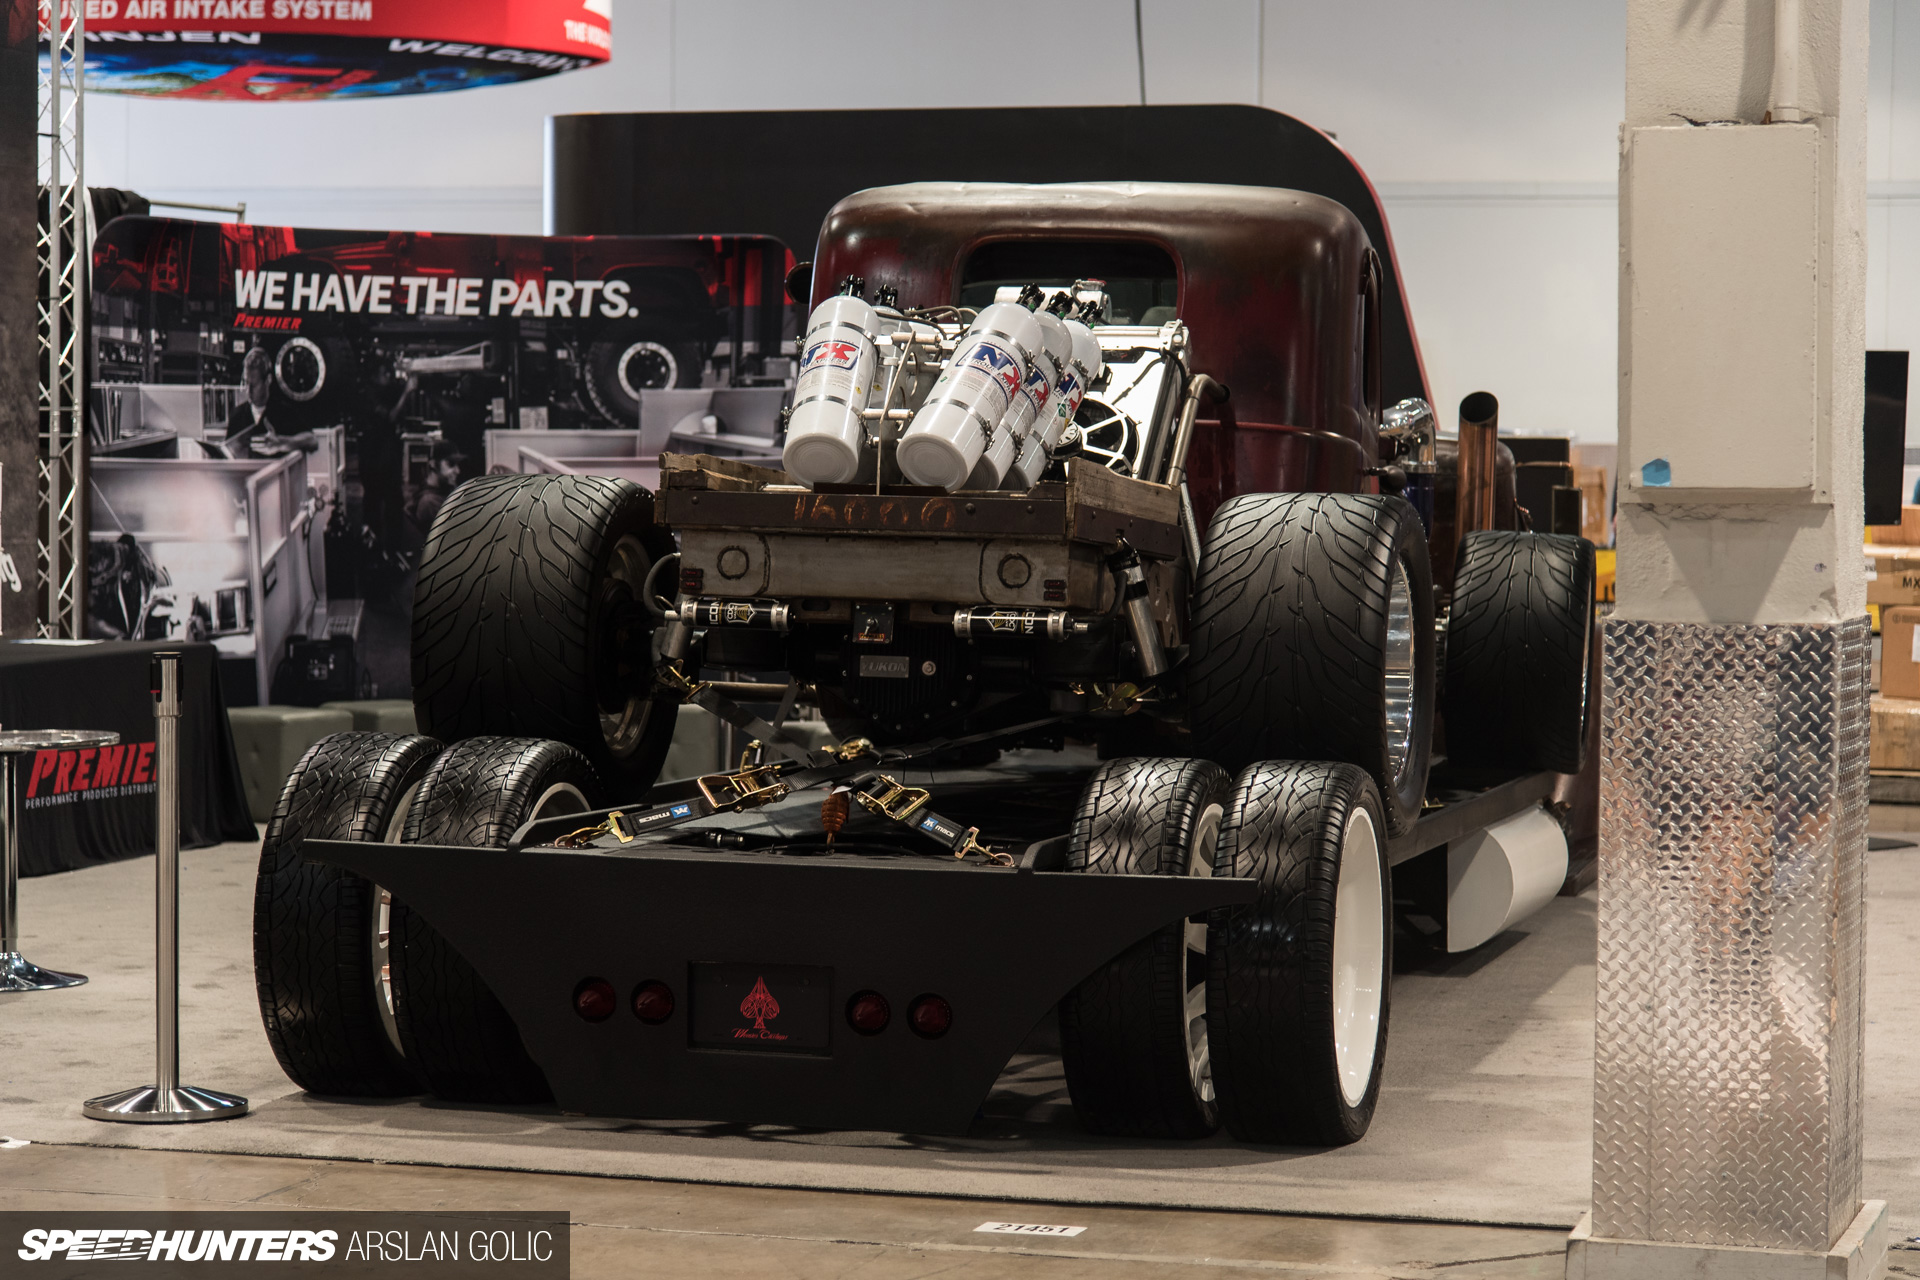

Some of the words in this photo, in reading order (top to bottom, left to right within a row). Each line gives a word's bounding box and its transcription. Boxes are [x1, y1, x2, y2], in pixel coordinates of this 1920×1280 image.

[124, 0, 172, 20] AIR
[174, 0, 265, 20] INTAKE
[271, 0, 373, 21] SYSTEM
[234, 269, 287, 310] WE
[292, 273, 394, 314] HAVE
[400, 276, 483, 316] THE
[489, 279, 639, 319] PARTS.
[233, 312, 302, 330] PREMIER
[709, 601, 720, 625] ICON
[1025, 611, 1036, 634] CON
[862, 662, 908, 673] YUKON
[26, 742, 157, 798] PREMIE
[25, 792, 79, 810] PERFORMANCE
[82, 786, 118, 801] PRODUCTS
[120, 782, 157, 796] DISTRIBUT
[993, 1223, 1070, 1234] 21451
